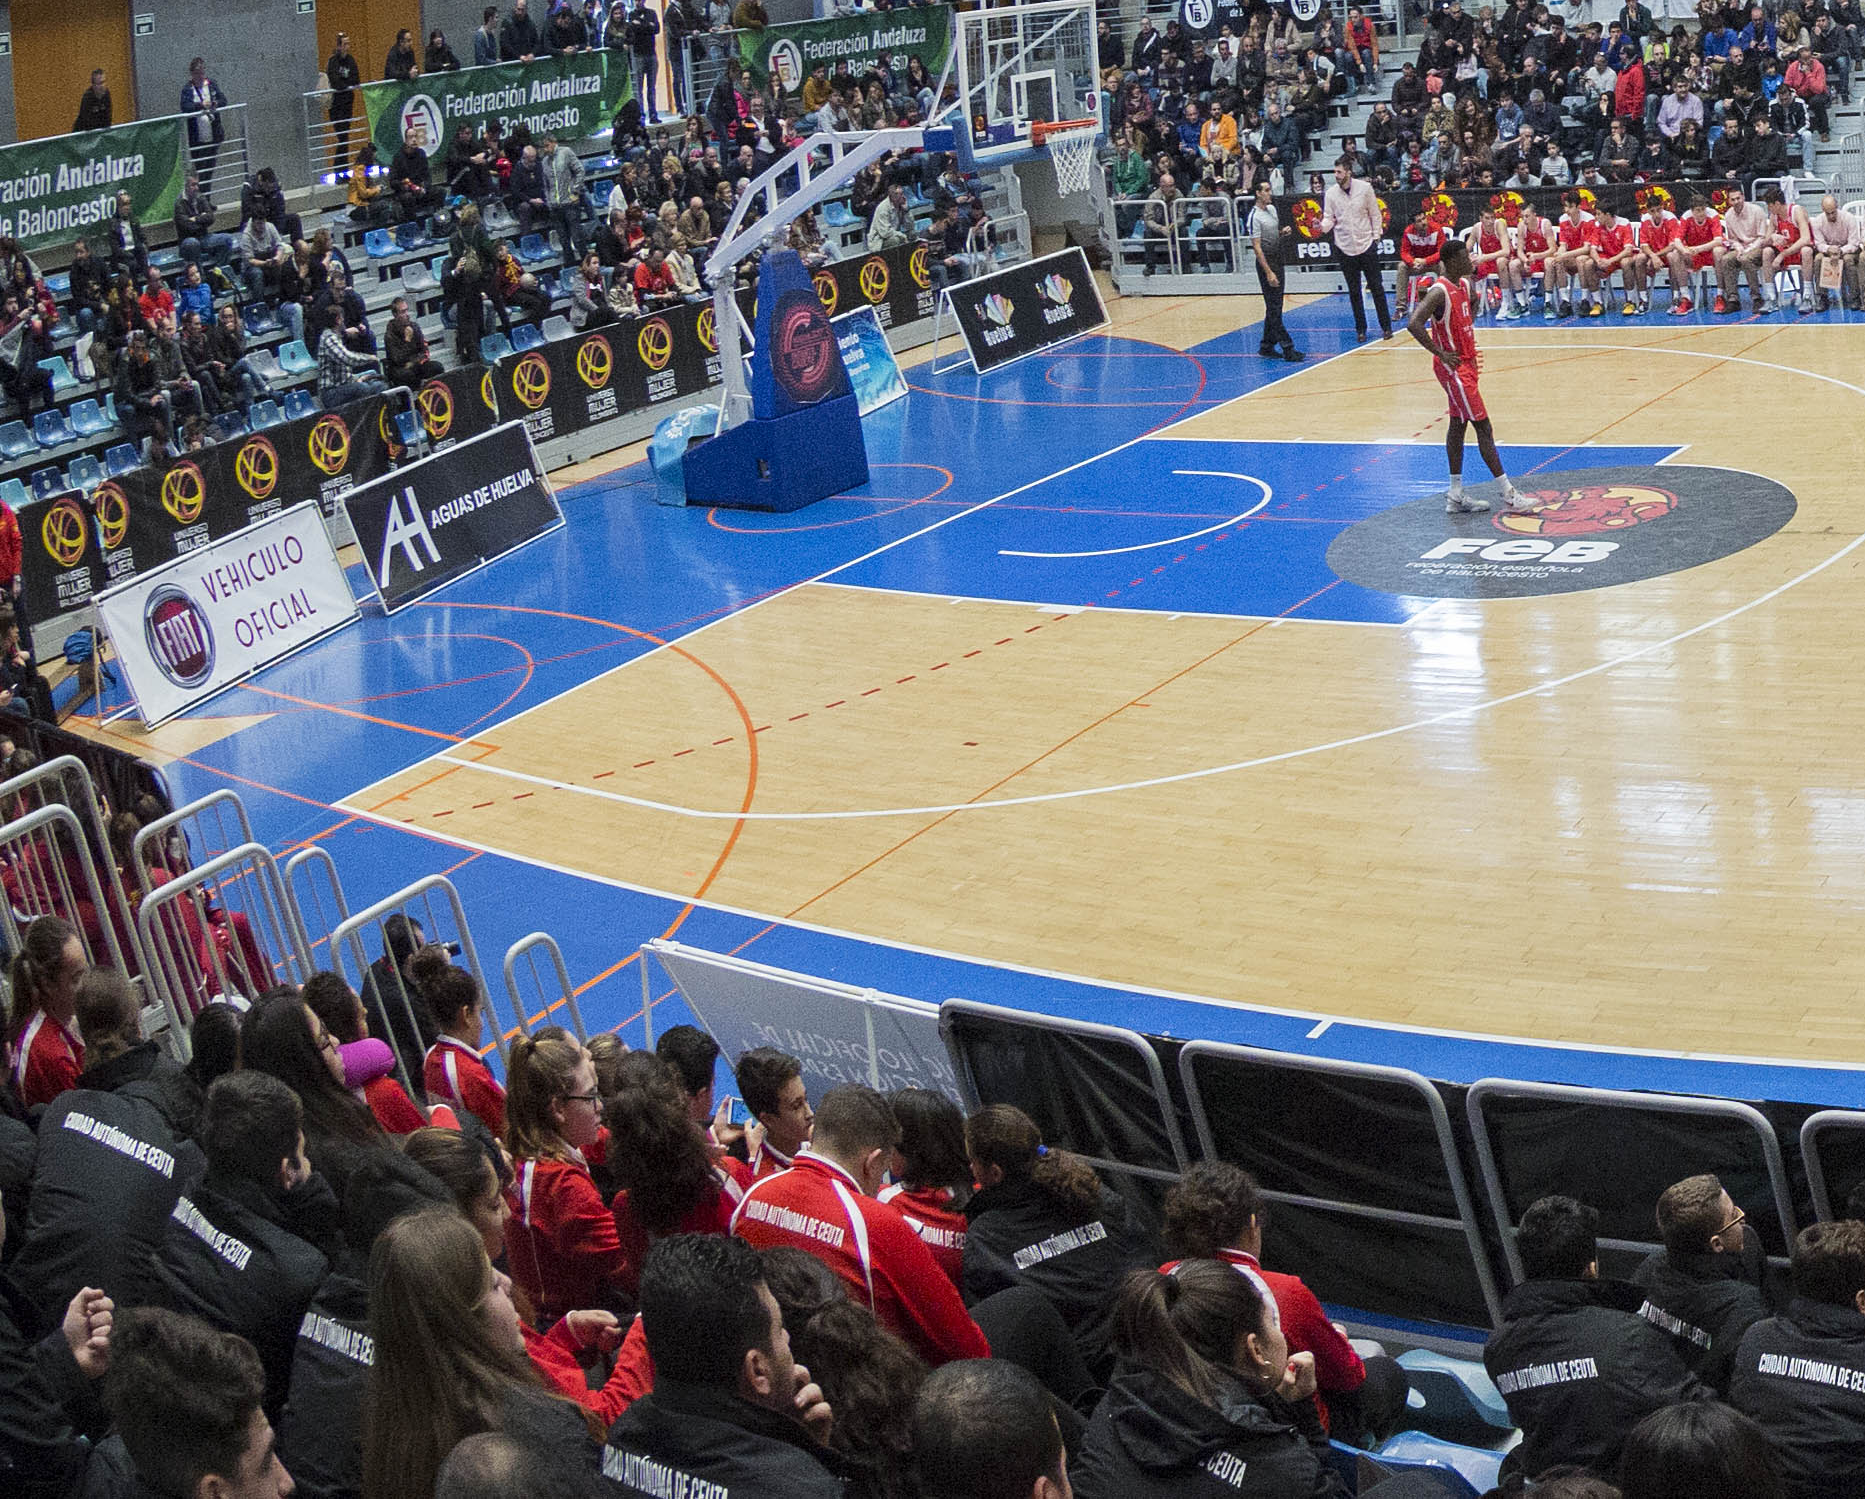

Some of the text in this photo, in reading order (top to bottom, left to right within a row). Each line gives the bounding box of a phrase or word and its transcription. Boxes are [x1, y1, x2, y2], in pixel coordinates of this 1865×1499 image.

[803, 26, 926, 59] Federación Andaluza
[444, 72, 600, 118] Federación Andaluza
[55, 151, 144, 193] Andaluza
[18, 194, 117, 236] Baloncesto
[588, 396, 617, 413] MUJER
[648, 377, 676, 394] MUJER
[431, 468, 535, 530] AGUAS DE HUELVA
[58, 576, 93, 597] MUJER
[200, 535, 303, 603] VEHICULO
[157, 609, 202, 666] FIAT
[234, 588, 317, 648] OFICIAL
[147, 1147, 175, 1179] CEUTA
[767, 1205, 845, 1248] AUTÓNOMA DE CEUTA
[1516, 1357, 1598, 1391] AUTÓNOMA DE CEUTA
[1758, 1353, 1789, 1376] CIUDAD
[1788, 1356, 1837, 1386] AUTÓNOMA
[1837, 1367, 1849, 1388] DE
[1207, 1452, 1246, 1488] CEUTA
